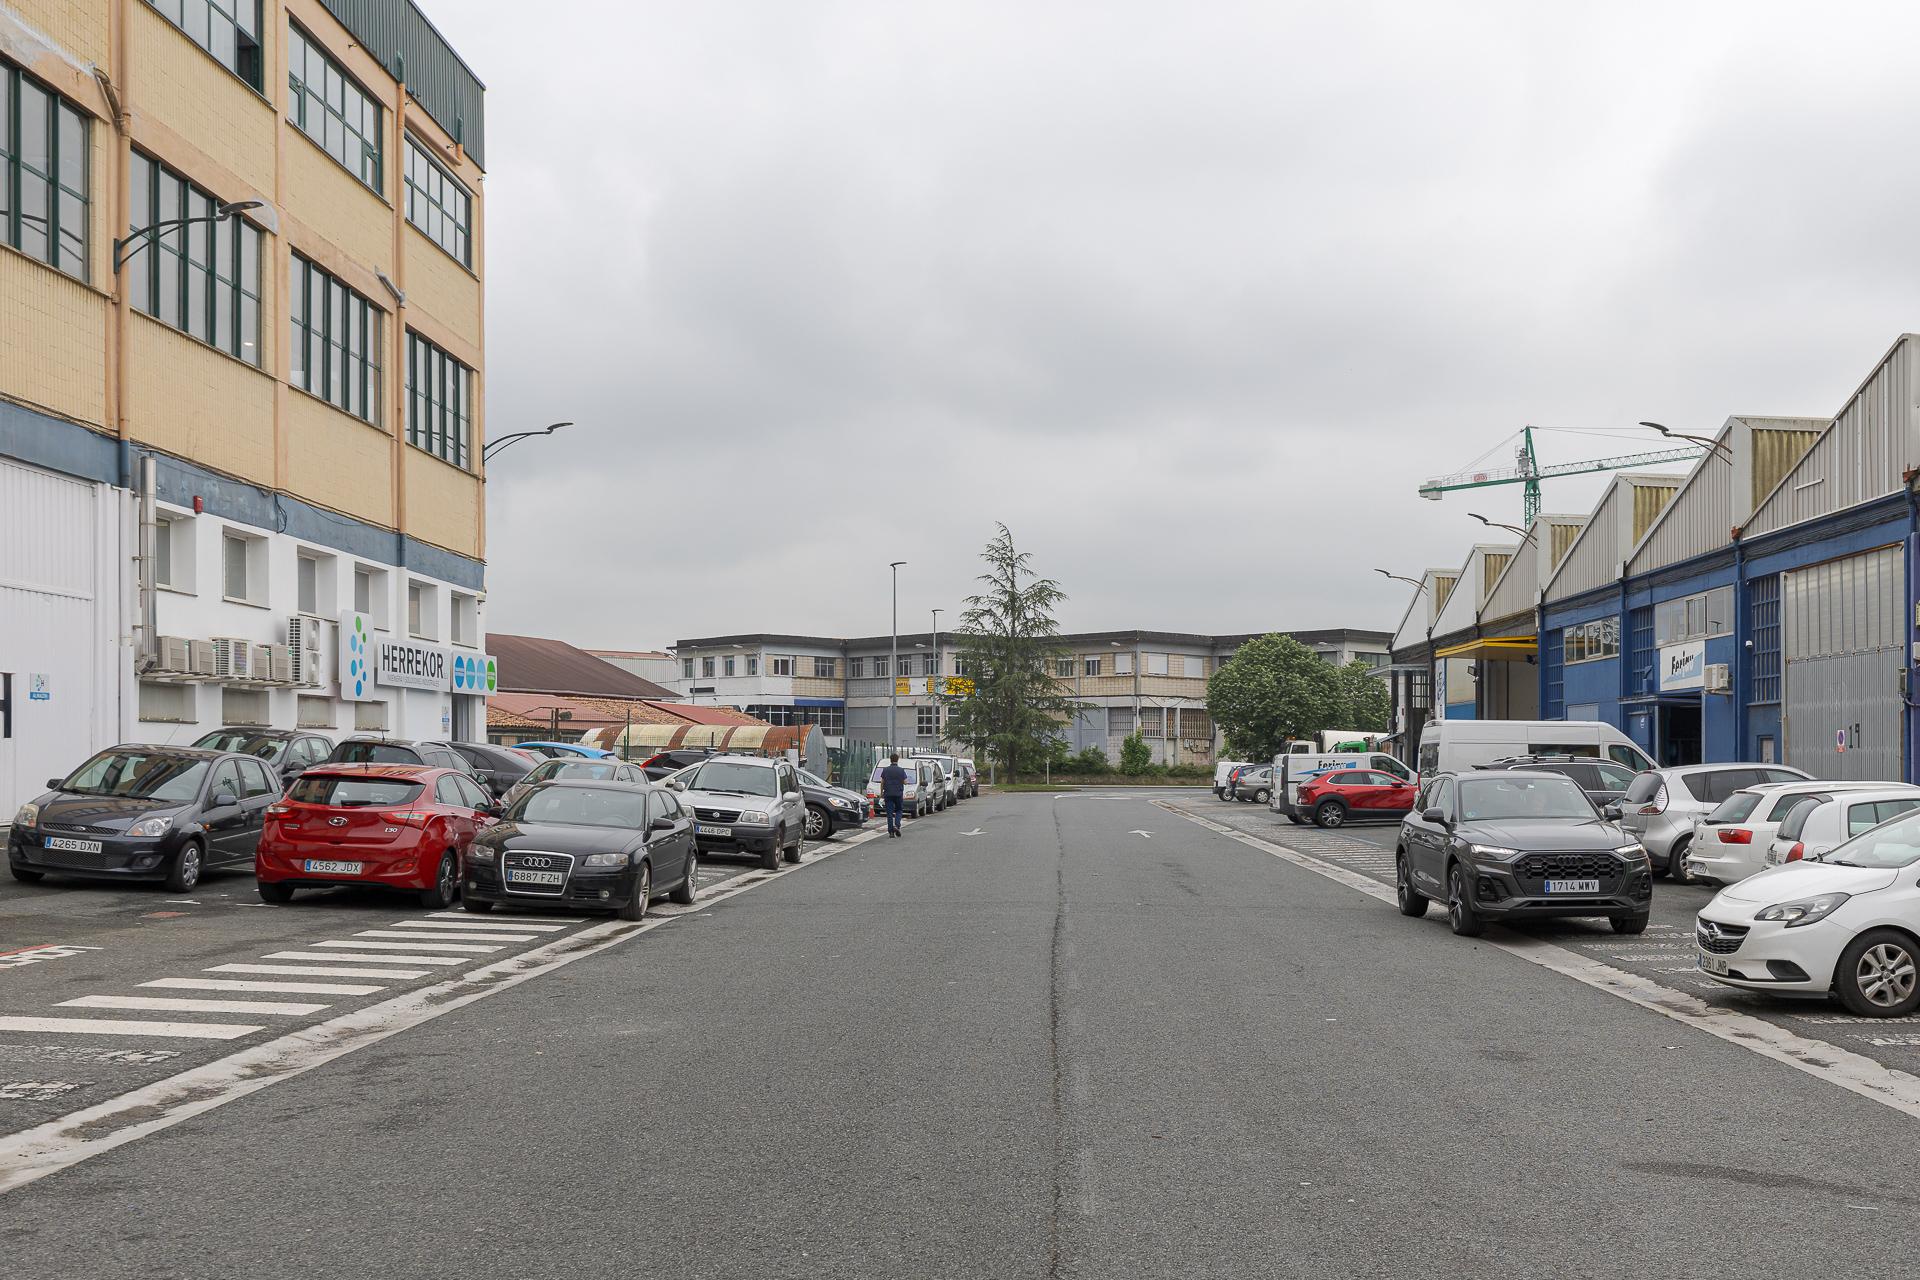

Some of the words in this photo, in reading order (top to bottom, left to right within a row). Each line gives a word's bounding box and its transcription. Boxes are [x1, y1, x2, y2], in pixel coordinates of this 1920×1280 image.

[382, 643, 444, 679] HERREKOR
[1849, 723, 1860, 749] 19
[52, 839, 77, 849] 4265
[80, 841, 100, 852] DXN
[312, 861, 337, 871] 4562
[340, 862, 359, 872] JDX
[514, 871, 538, 882] 6887
[540, 873, 560, 883] FZH
[1552, 881, 1575, 891] 1714
[1578, 881, 1596, 891] MWV
